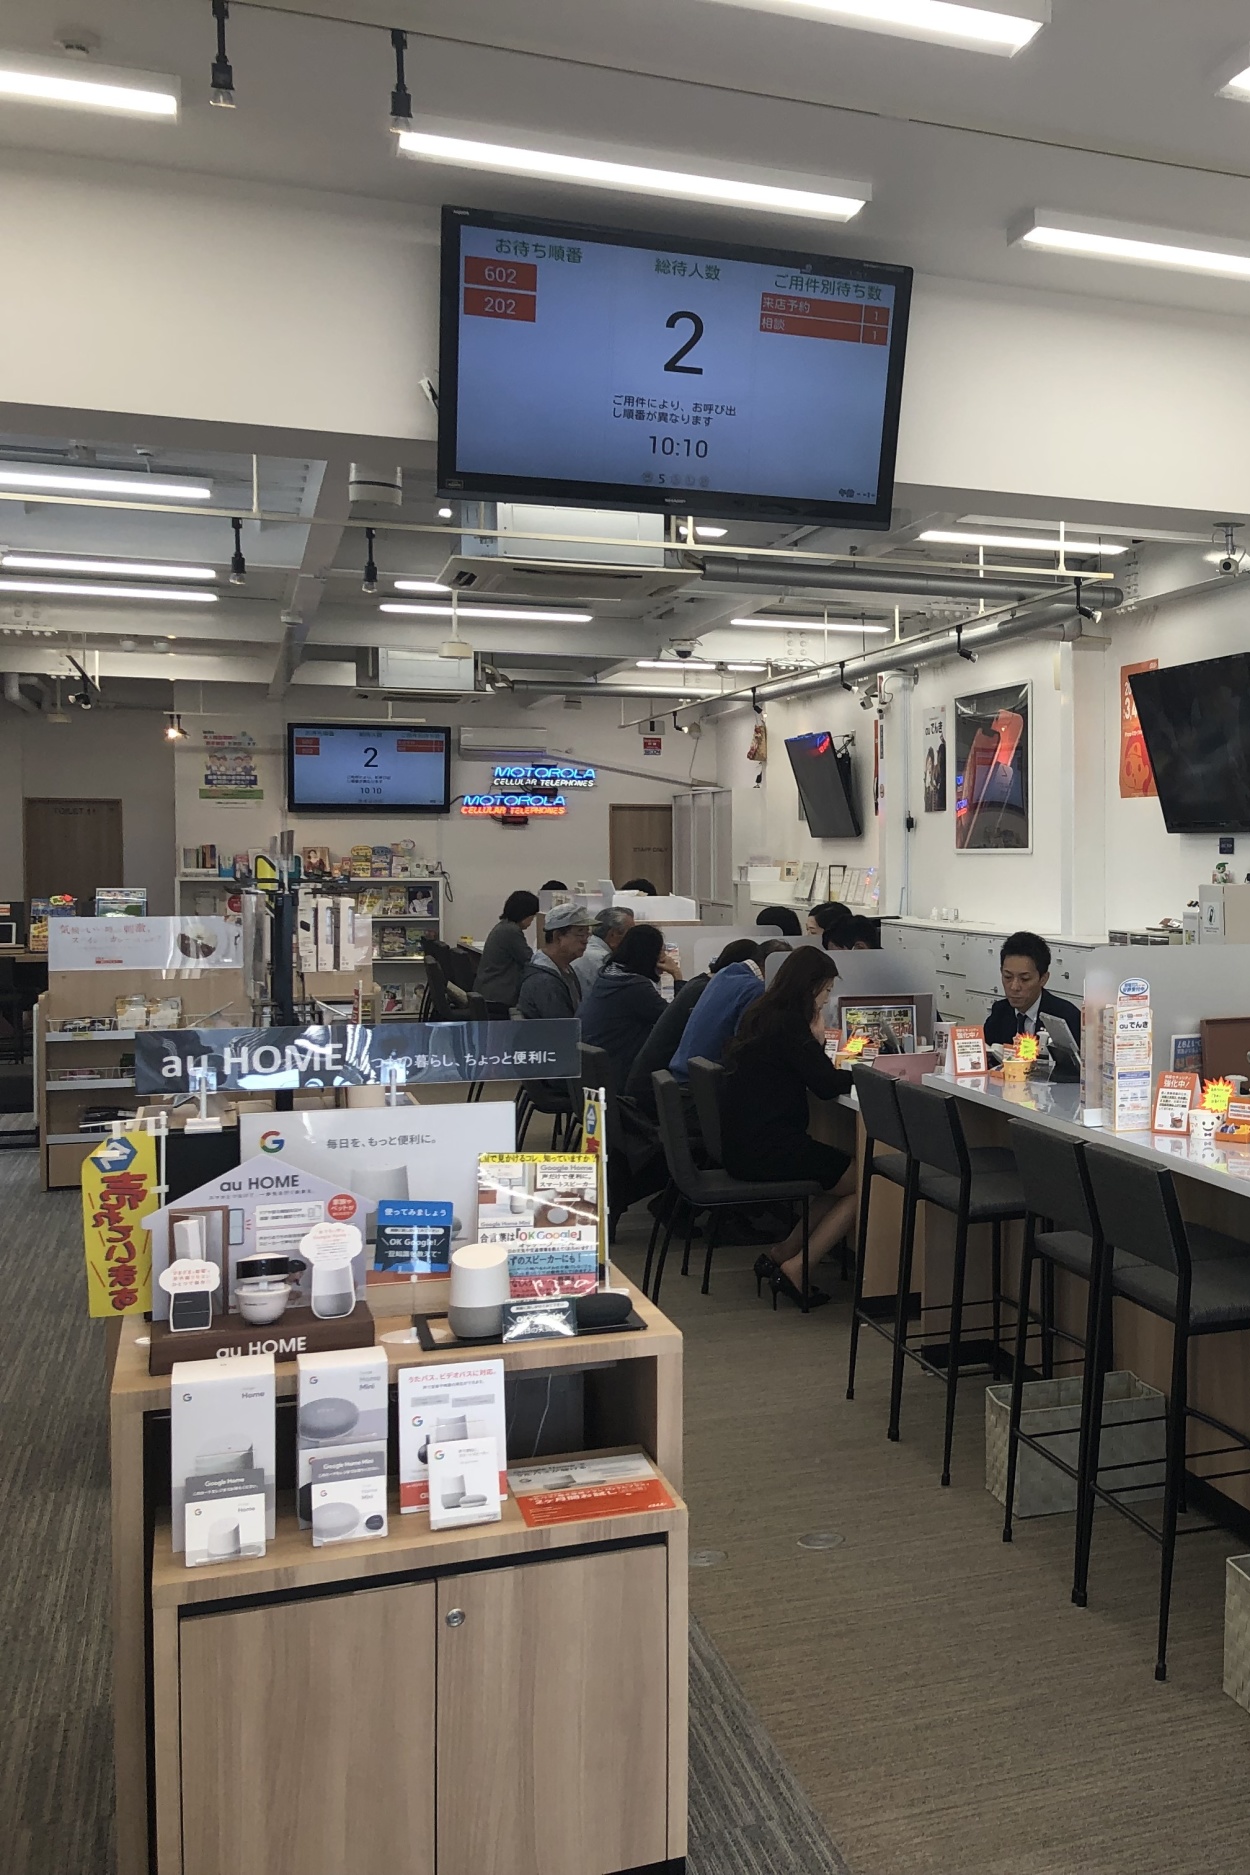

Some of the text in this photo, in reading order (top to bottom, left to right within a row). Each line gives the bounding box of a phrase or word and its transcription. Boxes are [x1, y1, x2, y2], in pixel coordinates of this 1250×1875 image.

[495, 238, 583, 264] お待ち順番
[484, 266, 517, 284] 602
[654, 258, 720, 281] 総待人数
[774, 274, 882, 301] ご用件別待ち数
[484, 296, 516, 315] 202
[762, 297, 811, 313] 来店予約
[761, 317, 785, 331] 相談
[664, 311, 704, 375] 2
[612, 395, 736, 417] ご用件により、お呼び出
[612, 407, 713, 427] し順番が異なります
[649, 435, 708, 459] 10:10
[658, 474, 665, 484] 5
[363, 747, 378, 768] 2
[494, 767, 596, 779] MOTOROLA
[493, 778, 594, 787] CELLULAR TELEPHONES
[463, 795, 566, 806] MOTOROLA
[460, 806, 566, 815] CELLULAR TELEPHONES
[161, 1043, 343, 1078] au HOME
[327, 1134, 436, 1149] 毎日を、もっと便利に。
[540, 1164, 568, 1172] Google
[220, 1175, 299, 1192] au HOME
[384, 1208, 447, 1217] 使ってみましょう
[92, 1172, 148, 1311] 売れています
[389, 1238, 402, 1246] OK
[248, 1336, 307, 1356] HOME
[242, 1391, 265, 1399] Home
[323, 1458, 374, 1470] Google Home Mini
[205, 1477, 245, 1488] Google Home
